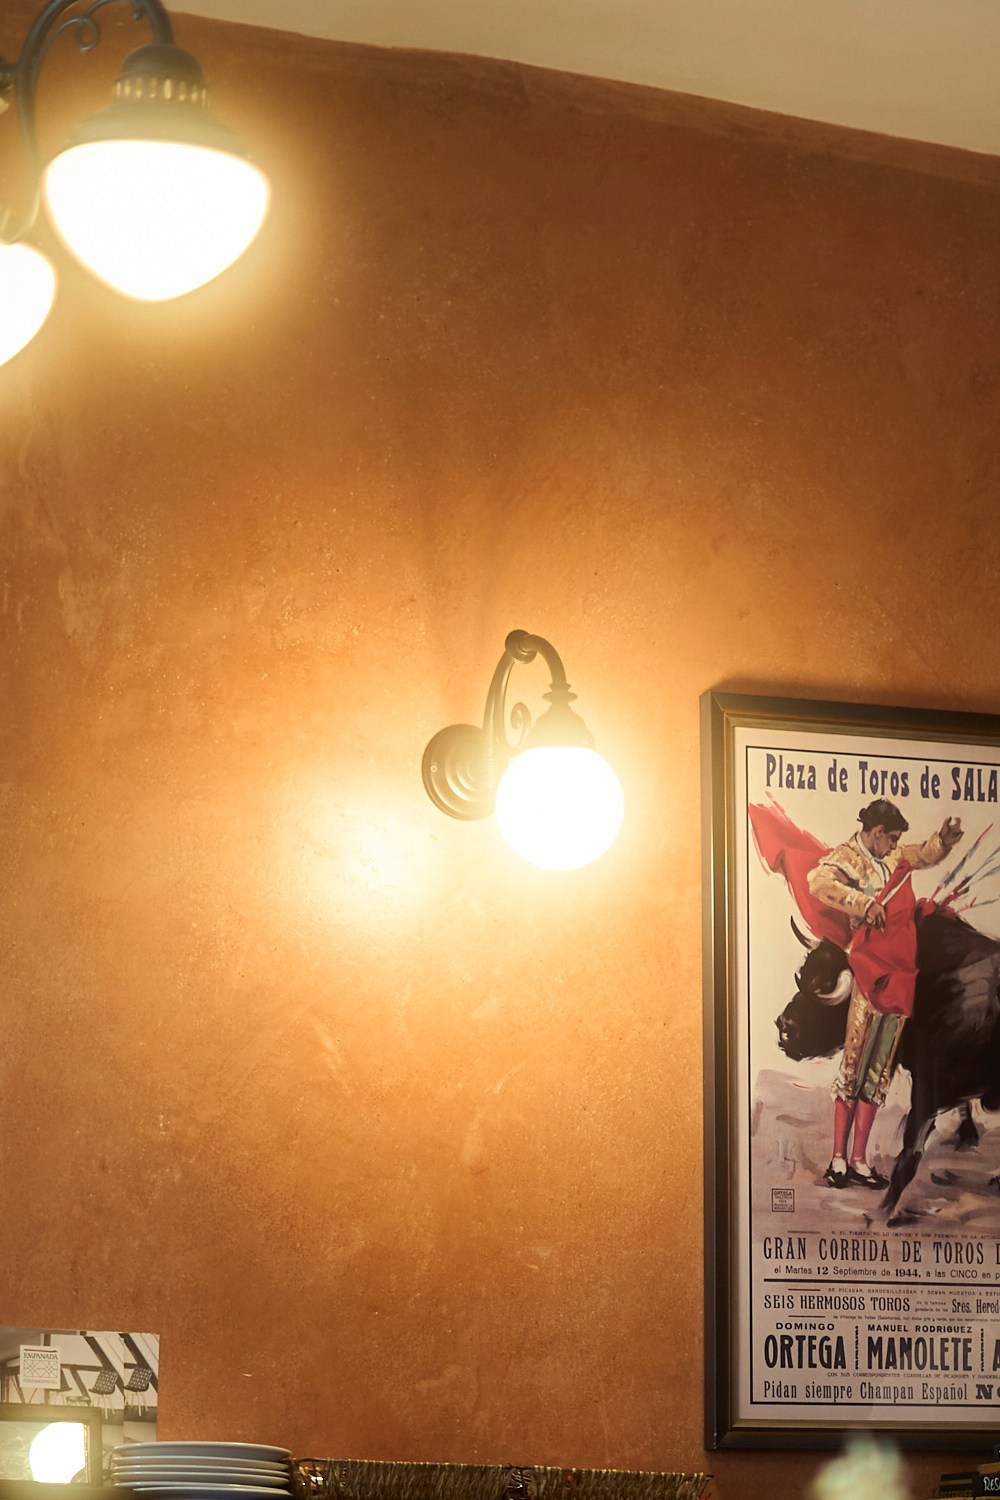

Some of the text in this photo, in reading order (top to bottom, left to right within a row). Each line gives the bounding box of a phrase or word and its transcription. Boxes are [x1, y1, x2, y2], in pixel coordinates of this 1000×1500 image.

[765, 752, 817, 791] Plaza
[827, 758, 849, 793] de
[858, 761, 910, 798] Toros
[920, 765, 941, 799] de
[763, 1237, 807, 1260] GRAN
[819, 1238, 890, 1262] CORRIDA
[902, 1240, 922, 1263] DE
[933, 1241, 984, 1264] TOROS
[774, 1266, 781, 1274] el
[786, 1266, 812, 1275] Martes
[817, 1266, 829, 1275] 12
[833, 1266, 877, 1277] Septiembre
[881, 1268, 891, 1276] de
[935, 1270, 946, 1278] las
[950, 1270, 978, 1279] CINCO
[764, 1294, 910, 1312] SEIS HERMOSOS TOROS
[952, 1298, 972, 1314] Sres.
[776, 1322, 836, 1331] DOMINGO
[868, 1324, 973, 1334] MANUEL RODRIGUEZ
[24, 1352, 58, 1360] EMPANADA
[764, 1334, 847, 1370] ORTEGA
[867, 1336, 973, 1372] MANOLETE
[764, 1380, 797, 1399] Pidan
[805, 1381, 853, 1402] siempre
[860, 1382, 914, 1403] Champan
[922, 1382, 968, 1403] Español
